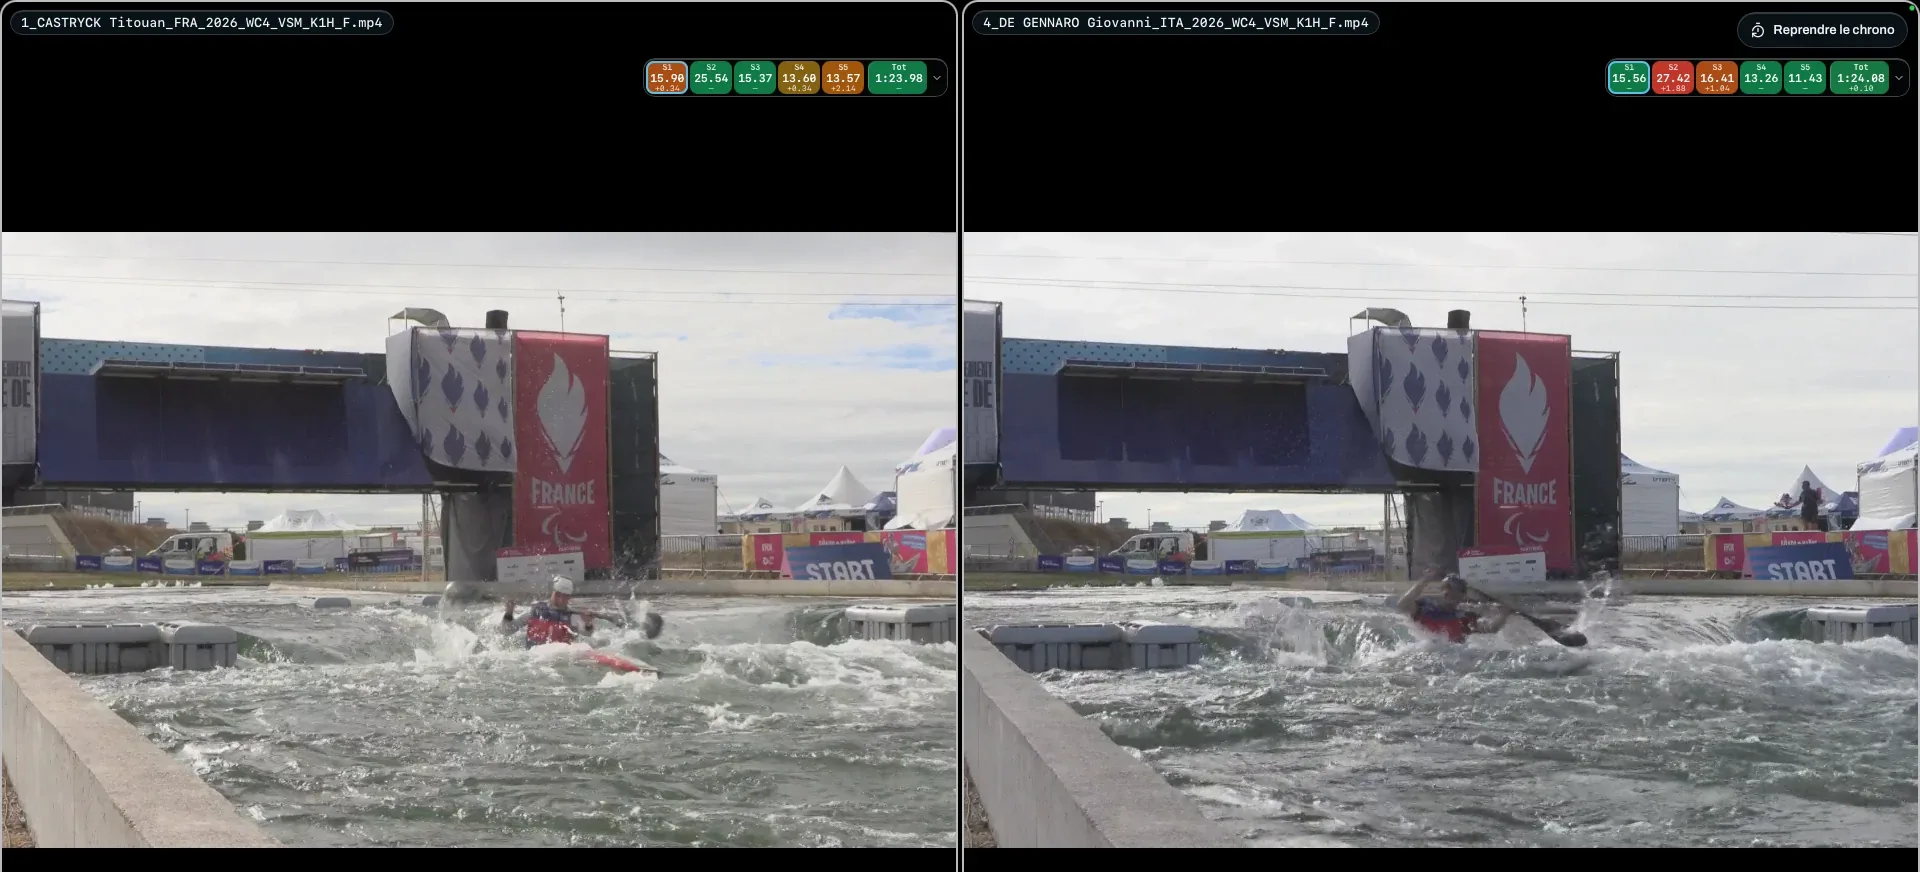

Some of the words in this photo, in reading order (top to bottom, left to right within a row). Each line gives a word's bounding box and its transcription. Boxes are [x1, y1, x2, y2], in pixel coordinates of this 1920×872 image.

[12, 378, 31, 408] DE
[973, 378, 993, 408] DE
[532, 476, 595, 505] FRANCE
[1493, 476, 1557, 505] FRANCE
[806, 559, 875, 580] START
[1767, 559, 1837, 580] START
